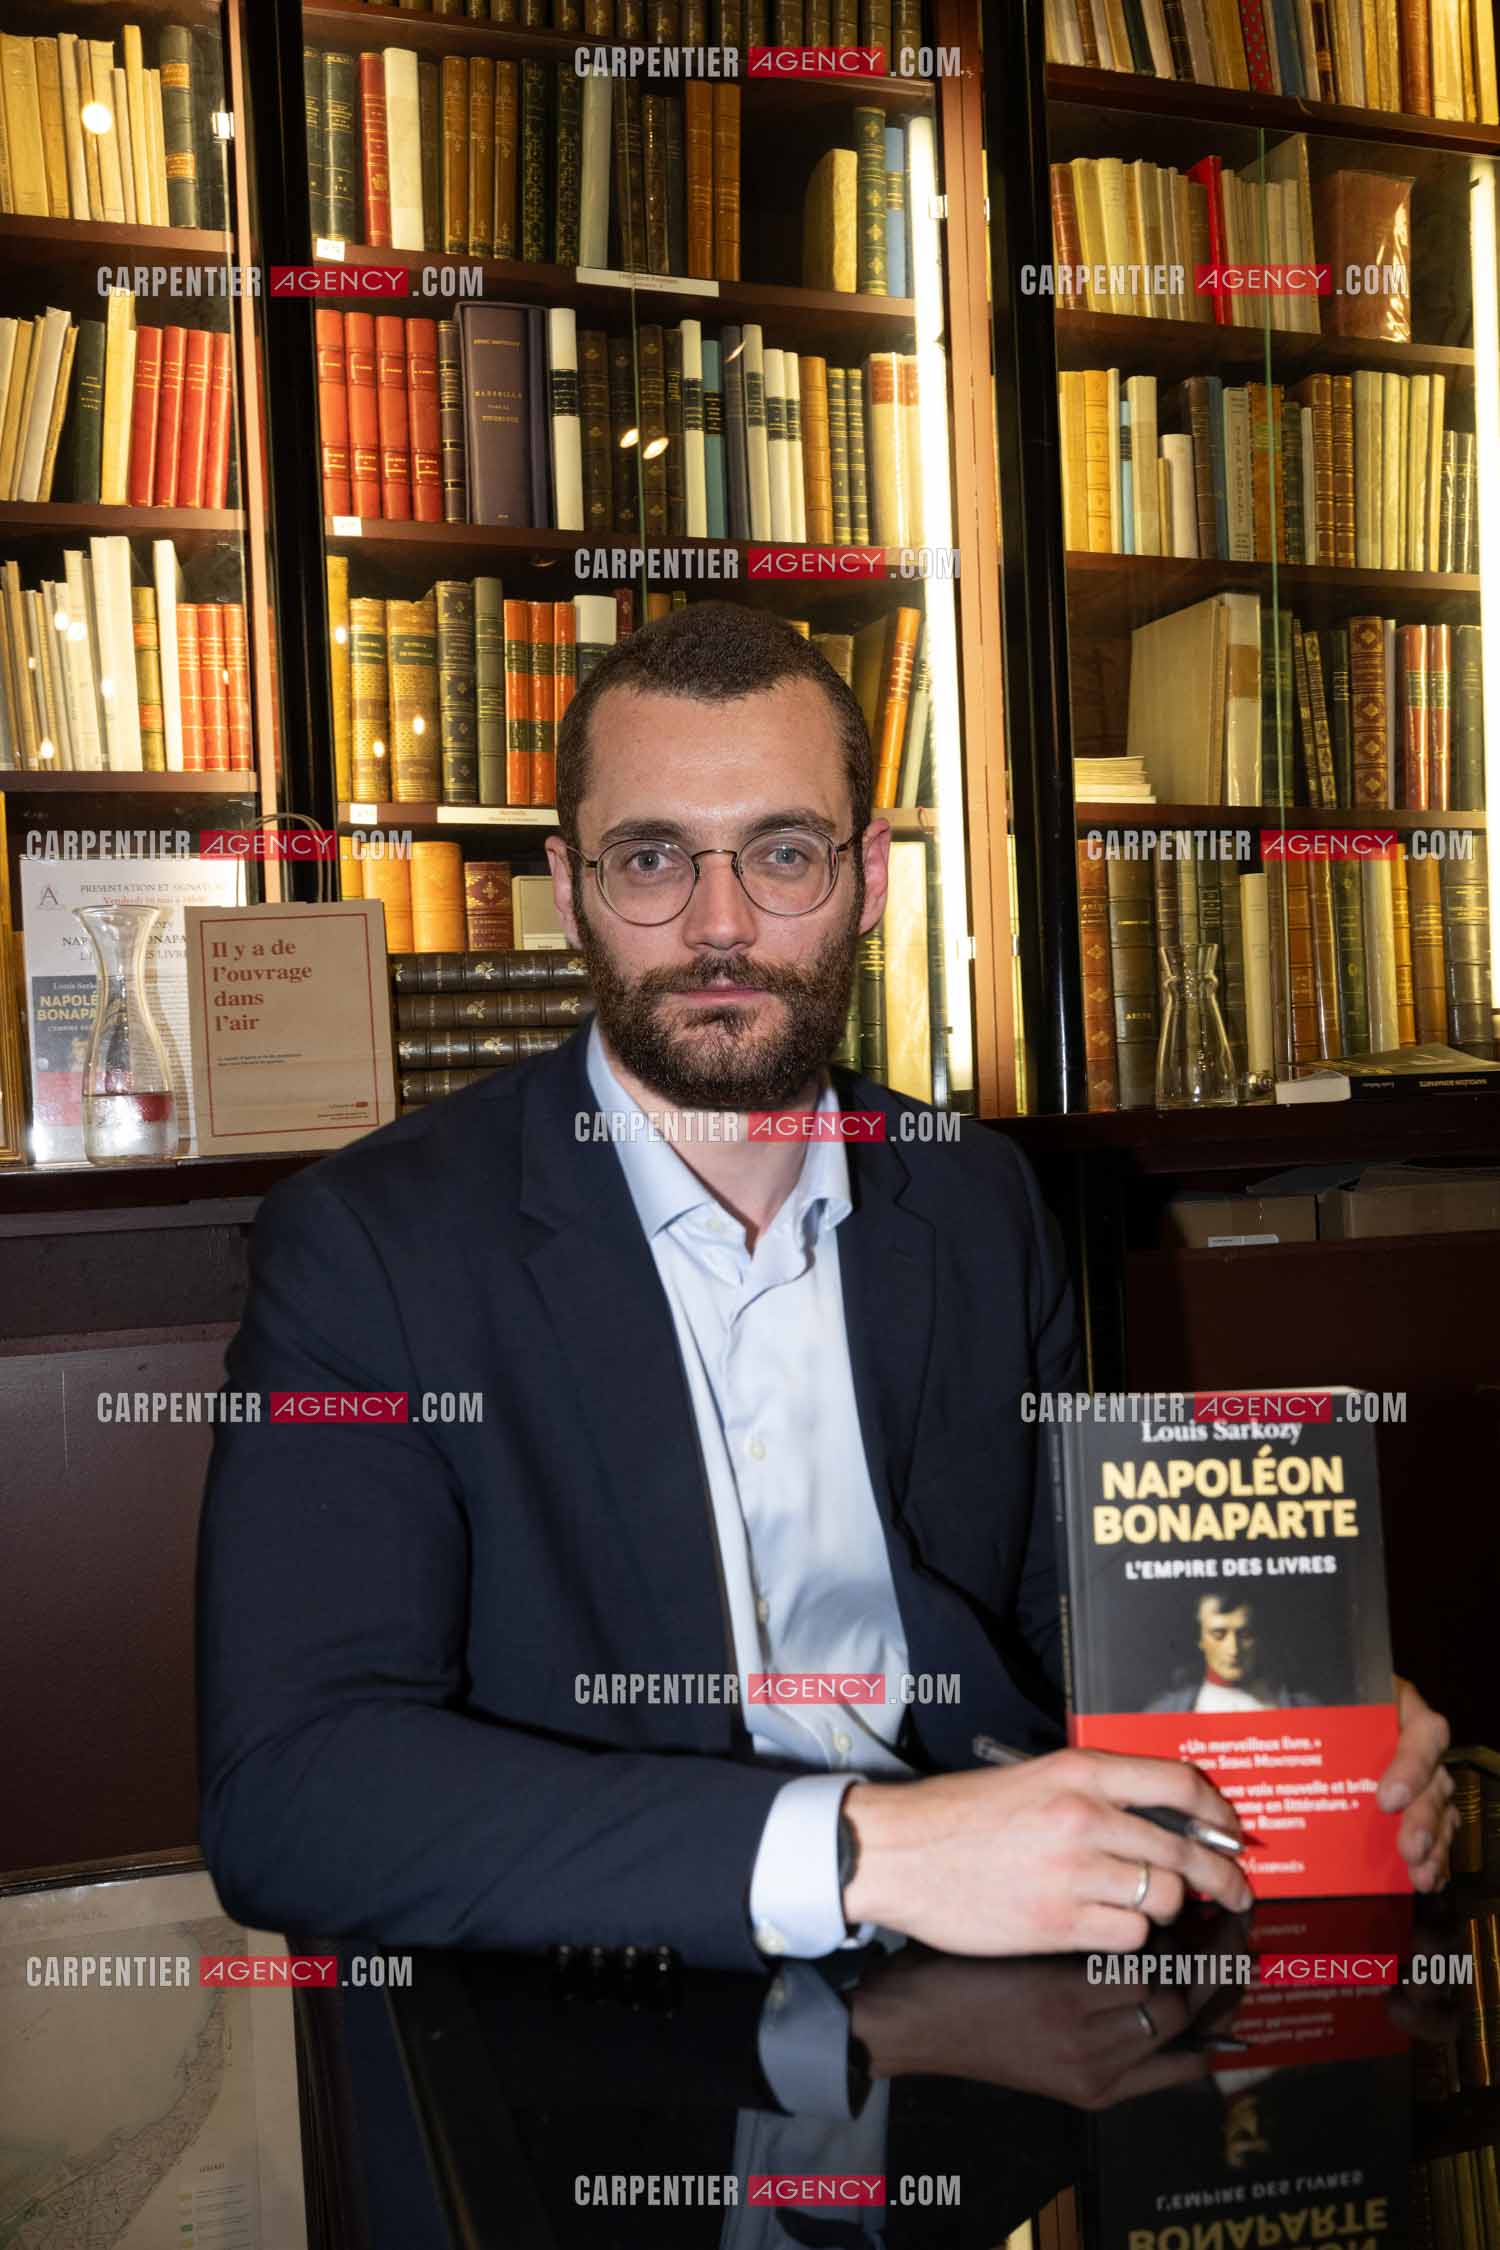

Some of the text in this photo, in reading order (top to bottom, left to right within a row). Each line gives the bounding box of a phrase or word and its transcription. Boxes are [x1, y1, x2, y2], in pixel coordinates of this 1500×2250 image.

[211, 939, 296, 961] Il y a de
[212, 965, 312, 983] l'ouvrage
[41, 991, 99, 1007] NAPOLÉ
[214, 990, 264, 1007] dans
[37, 1008, 97, 1021] BONAPA
[216, 1014, 260, 1031] l'air
[1141, 1418, 1302, 1446] Louis Sarkozy
[1102, 1444, 1345, 1500] NAPOLÉON
[1093, 1499, 1360, 1545] BONAPARTE
[1125, 1555, 1337, 1580] L'EMPIRE DES LIVRES
